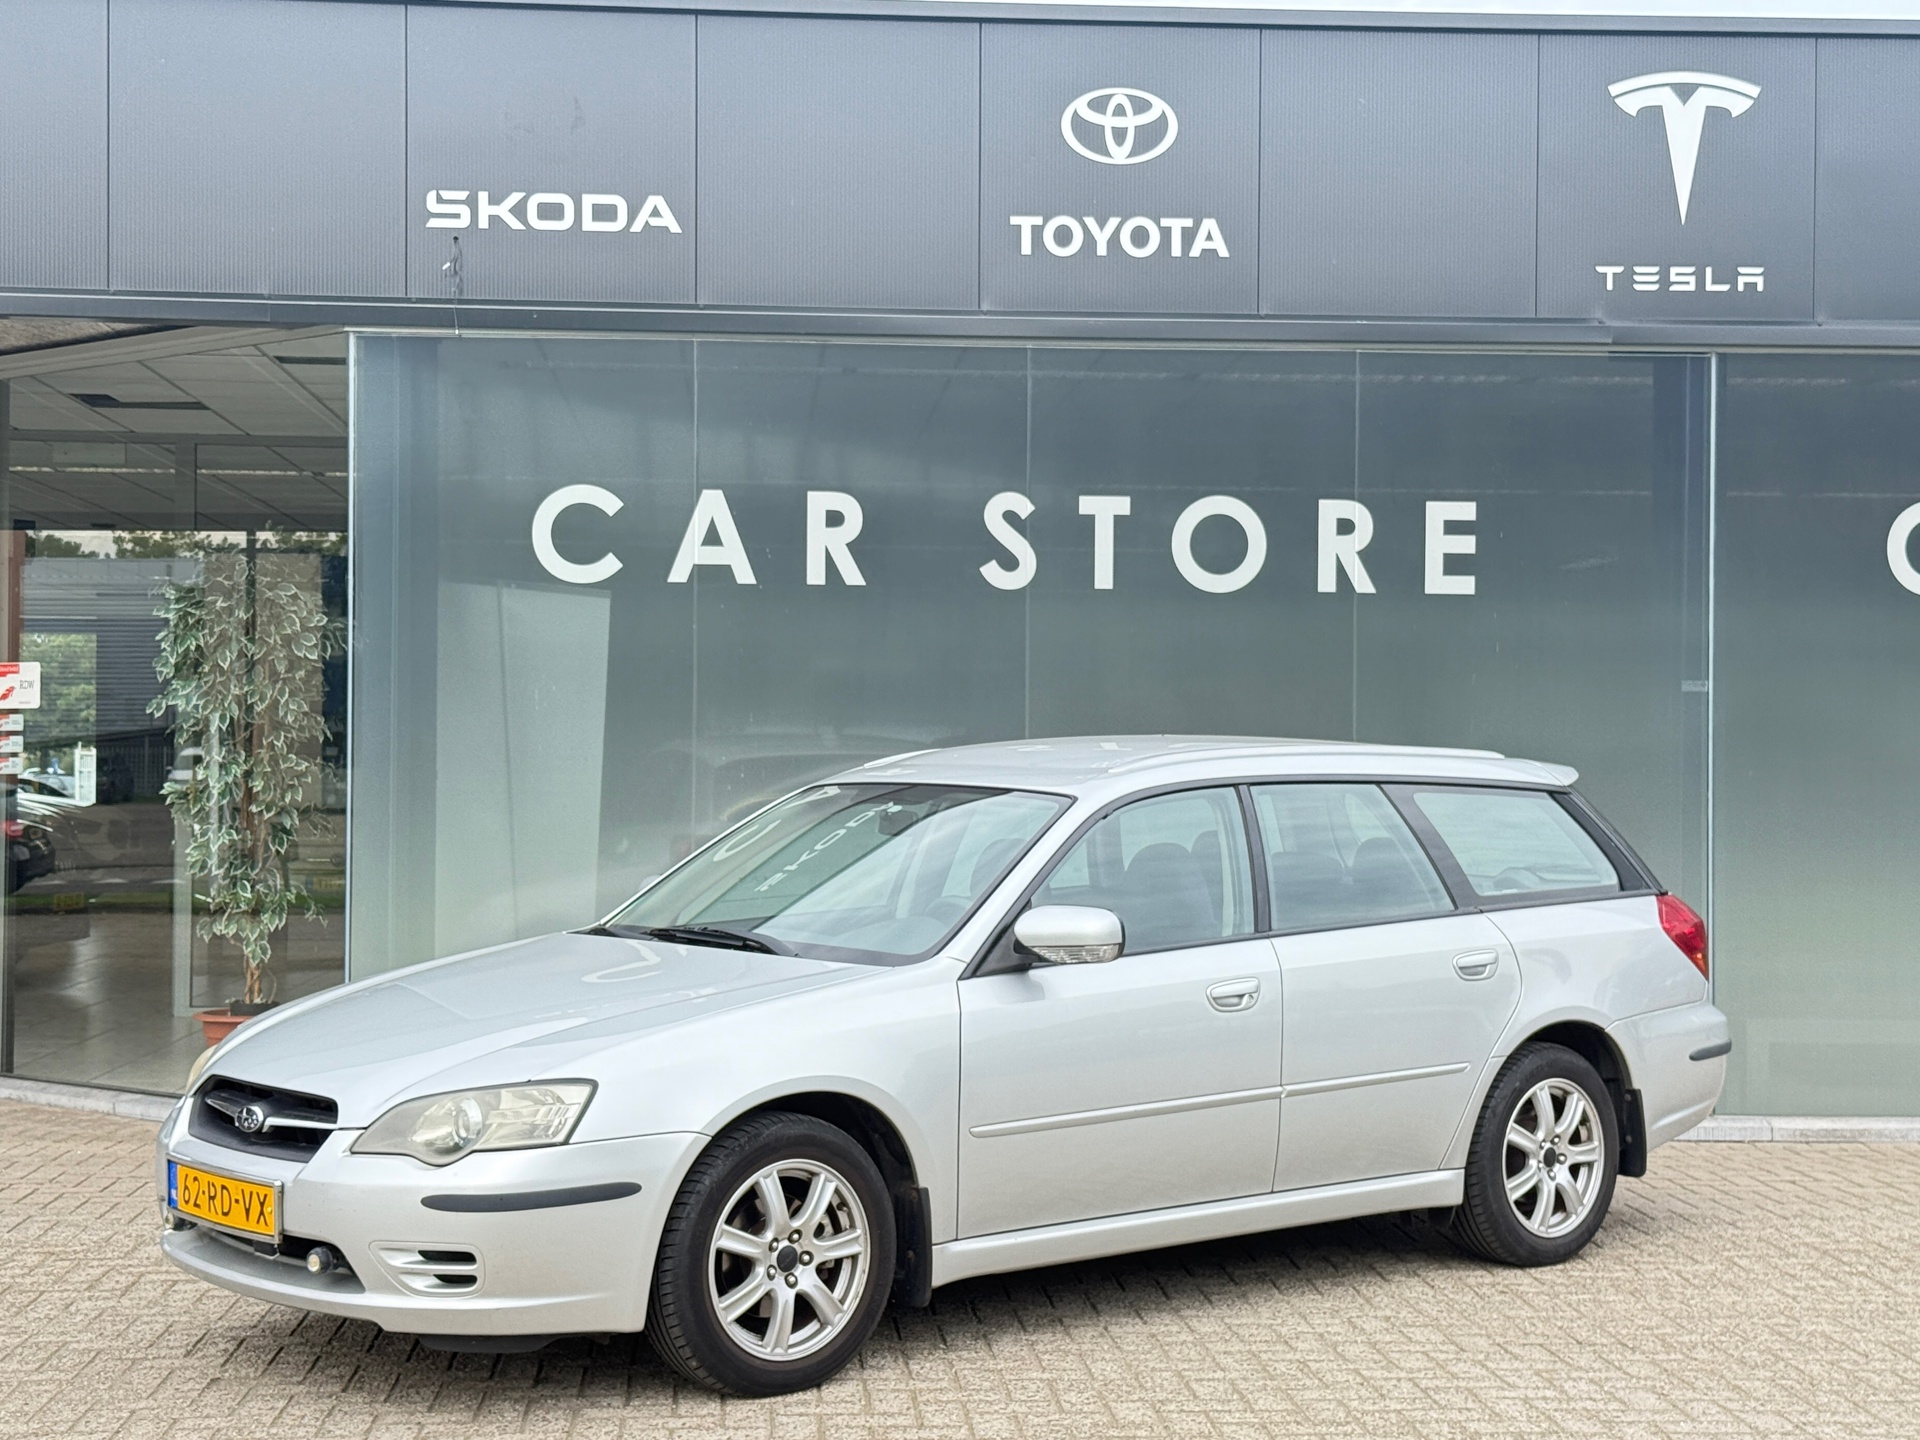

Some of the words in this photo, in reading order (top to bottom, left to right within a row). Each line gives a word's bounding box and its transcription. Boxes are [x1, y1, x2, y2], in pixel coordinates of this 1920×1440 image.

[1009, 215, 1230, 258] TOYOTA
[1595, 265, 1766, 292] TESLA
[531, 484, 866, 587] CAR
[979, 491, 1479, 596] STORE
[182, 1173, 269, 1227] 62-RD-VX
